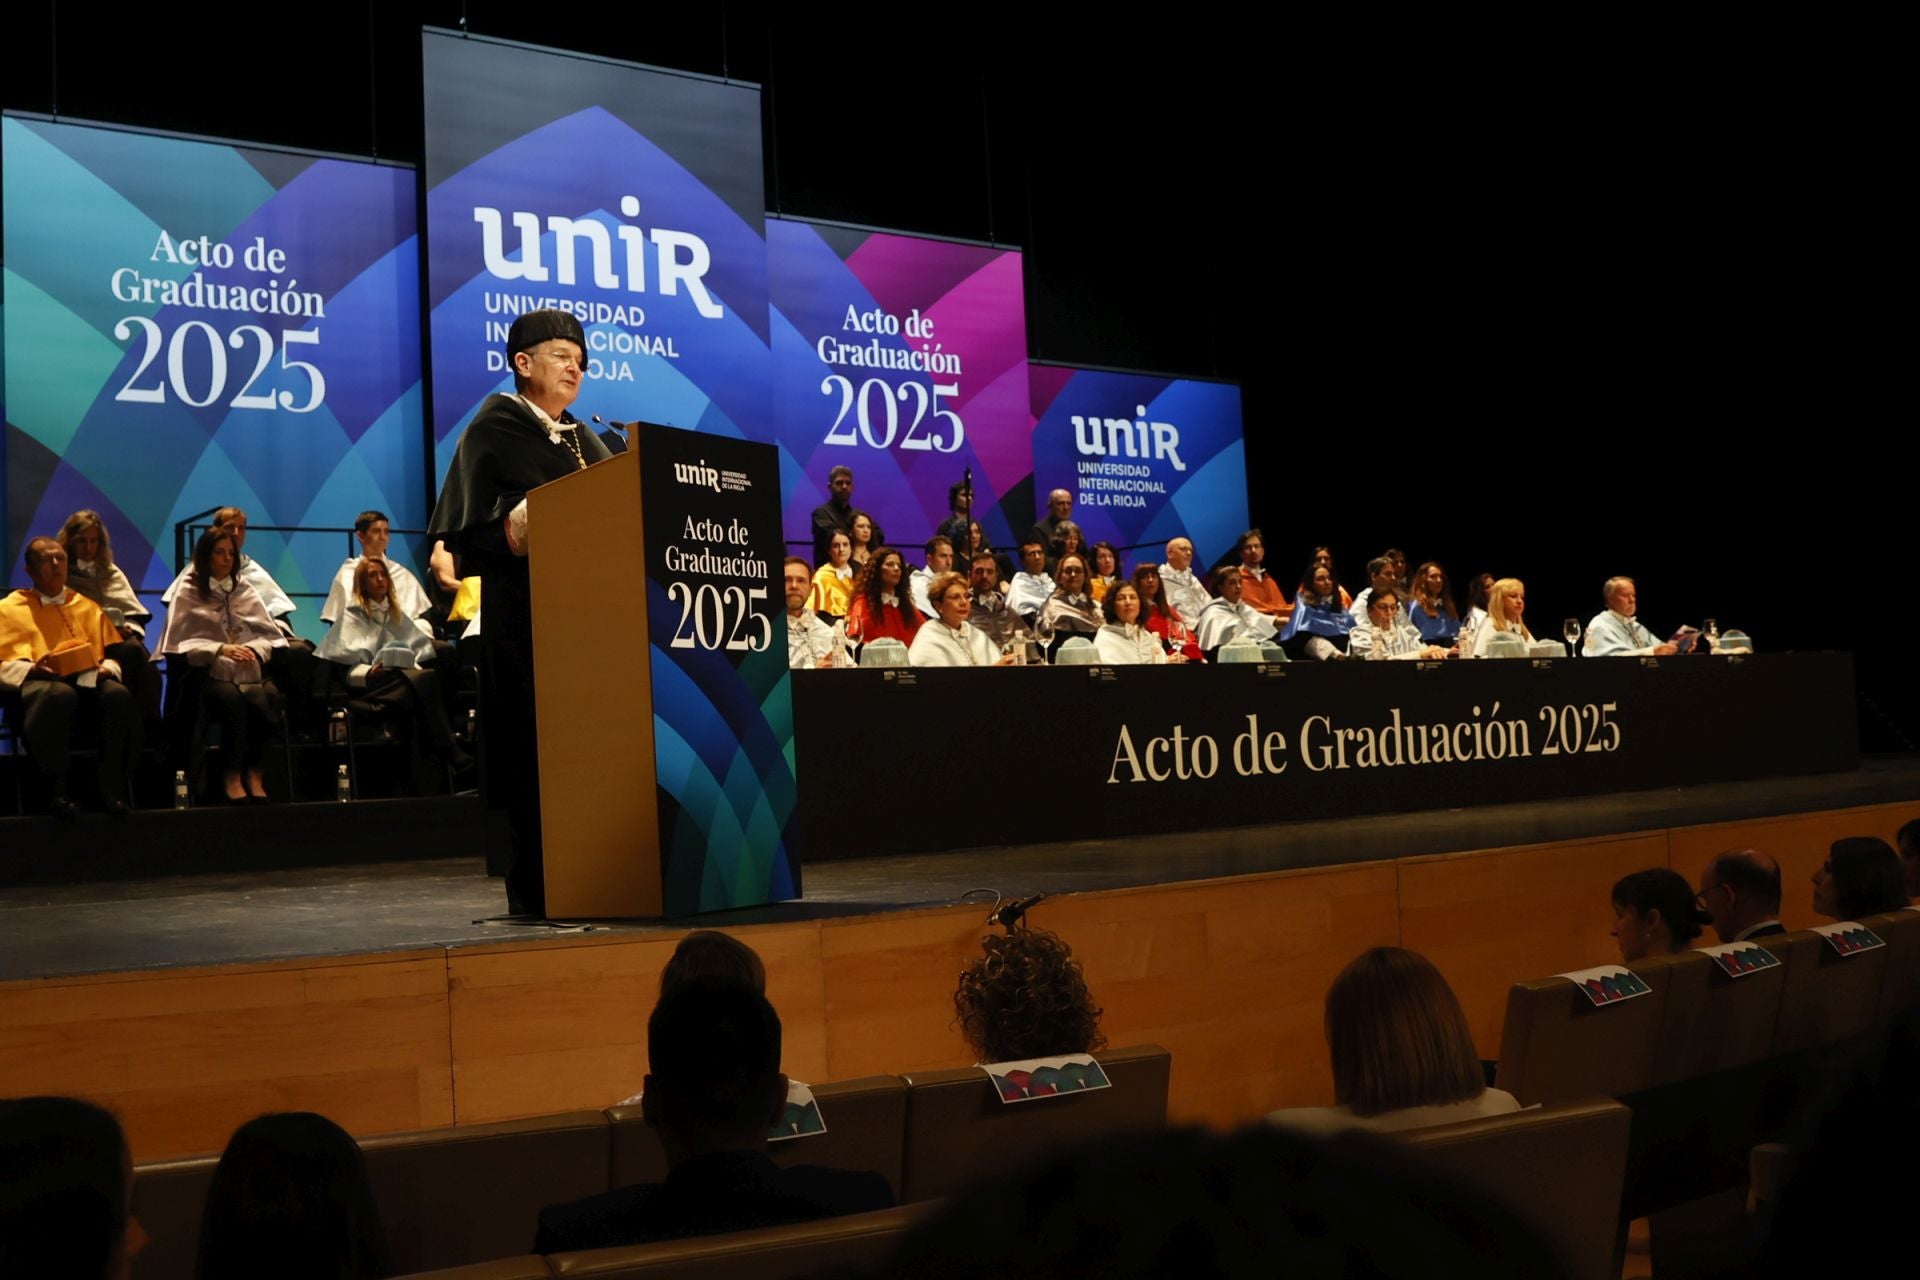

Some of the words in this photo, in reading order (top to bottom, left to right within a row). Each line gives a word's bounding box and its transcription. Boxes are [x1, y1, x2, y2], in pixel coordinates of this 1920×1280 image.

[150, 229, 234, 268] Acto
[244, 237, 286, 274] de
[111, 268, 326, 318] Graduación
[843, 304, 899, 335] Acto
[905, 309, 934, 339] de
[114, 316, 326, 413] 2025
[817, 335, 962, 375] Graduación
[820, 375, 965, 453] 2025
[1078, 461, 1151, 477] UNIVERSIDAD
[1078, 477, 1167, 493] INTERNACIONAL
[1080, 493, 1094, 505] DE
[1097, 494, 1111, 506] LA
[1113, 494, 1146, 508] RIOJA
[683, 514, 723, 543] Acto
[728, 518, 749, 546] de
[665, 545, 769, 579] Graduación
[668, 581, 772, 652] 2025
[1106, 723, 1219, 784] Acto
[1232, 713, 1287, 776] de
[1300, 701, 1532, 771] Graduación
[1539, 700, 1620, 756] 2025
